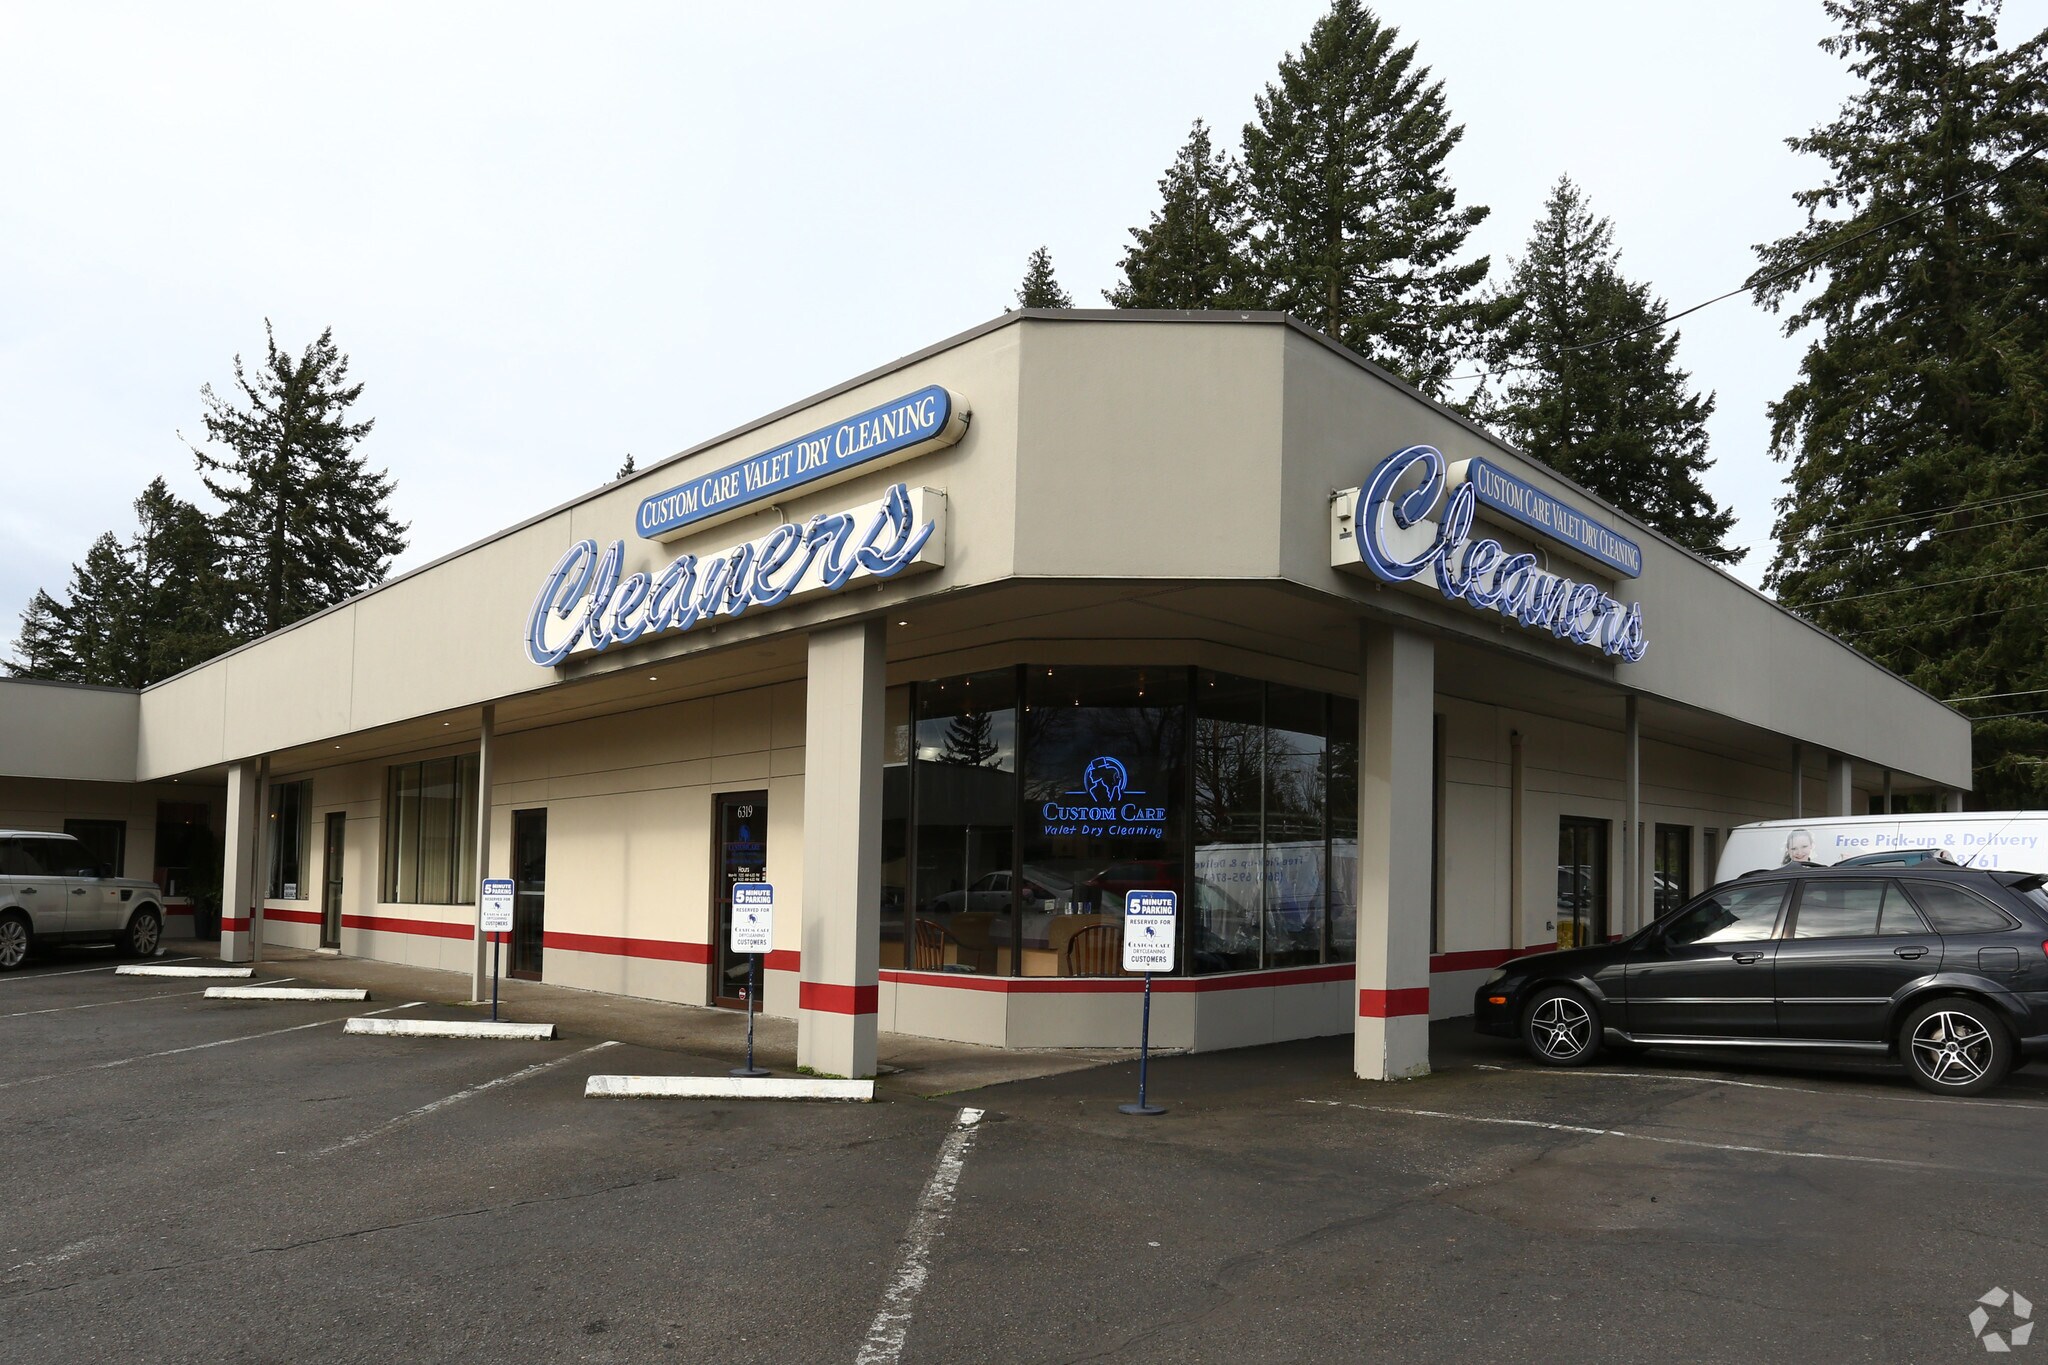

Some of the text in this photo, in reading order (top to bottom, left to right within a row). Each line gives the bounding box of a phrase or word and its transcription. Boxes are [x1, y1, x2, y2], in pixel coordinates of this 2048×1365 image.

[642, 396, 935, 529] CUSTOM CARE VALET DRY CLEANING
[1478, 464, 1639, 571] CUSTOM CARE VALET DRY CLEANING
[1355, 444, 1649, 663] Cleaners
[524, 483, 935, 667] Cleaners
[737, 804, 753, 819] 6319
[1042, 802, 1167, 822] CUSTOM CARE
[1044, 825, 1163, 839] Valet Dry Cleaning
[1836, 832, 2038, 850] Free Pick-up & Delivery
[484, 884, 492, 894] 5
[736, 890, 745, 903] 5
[745, 896, 771, 904] PARKING
[1129, 898, 1172, 914] 5 MINUTE
[1141, 906, 1173, 915] PARKING
[1131, 955, 1167, 963] CUSTOMERS
